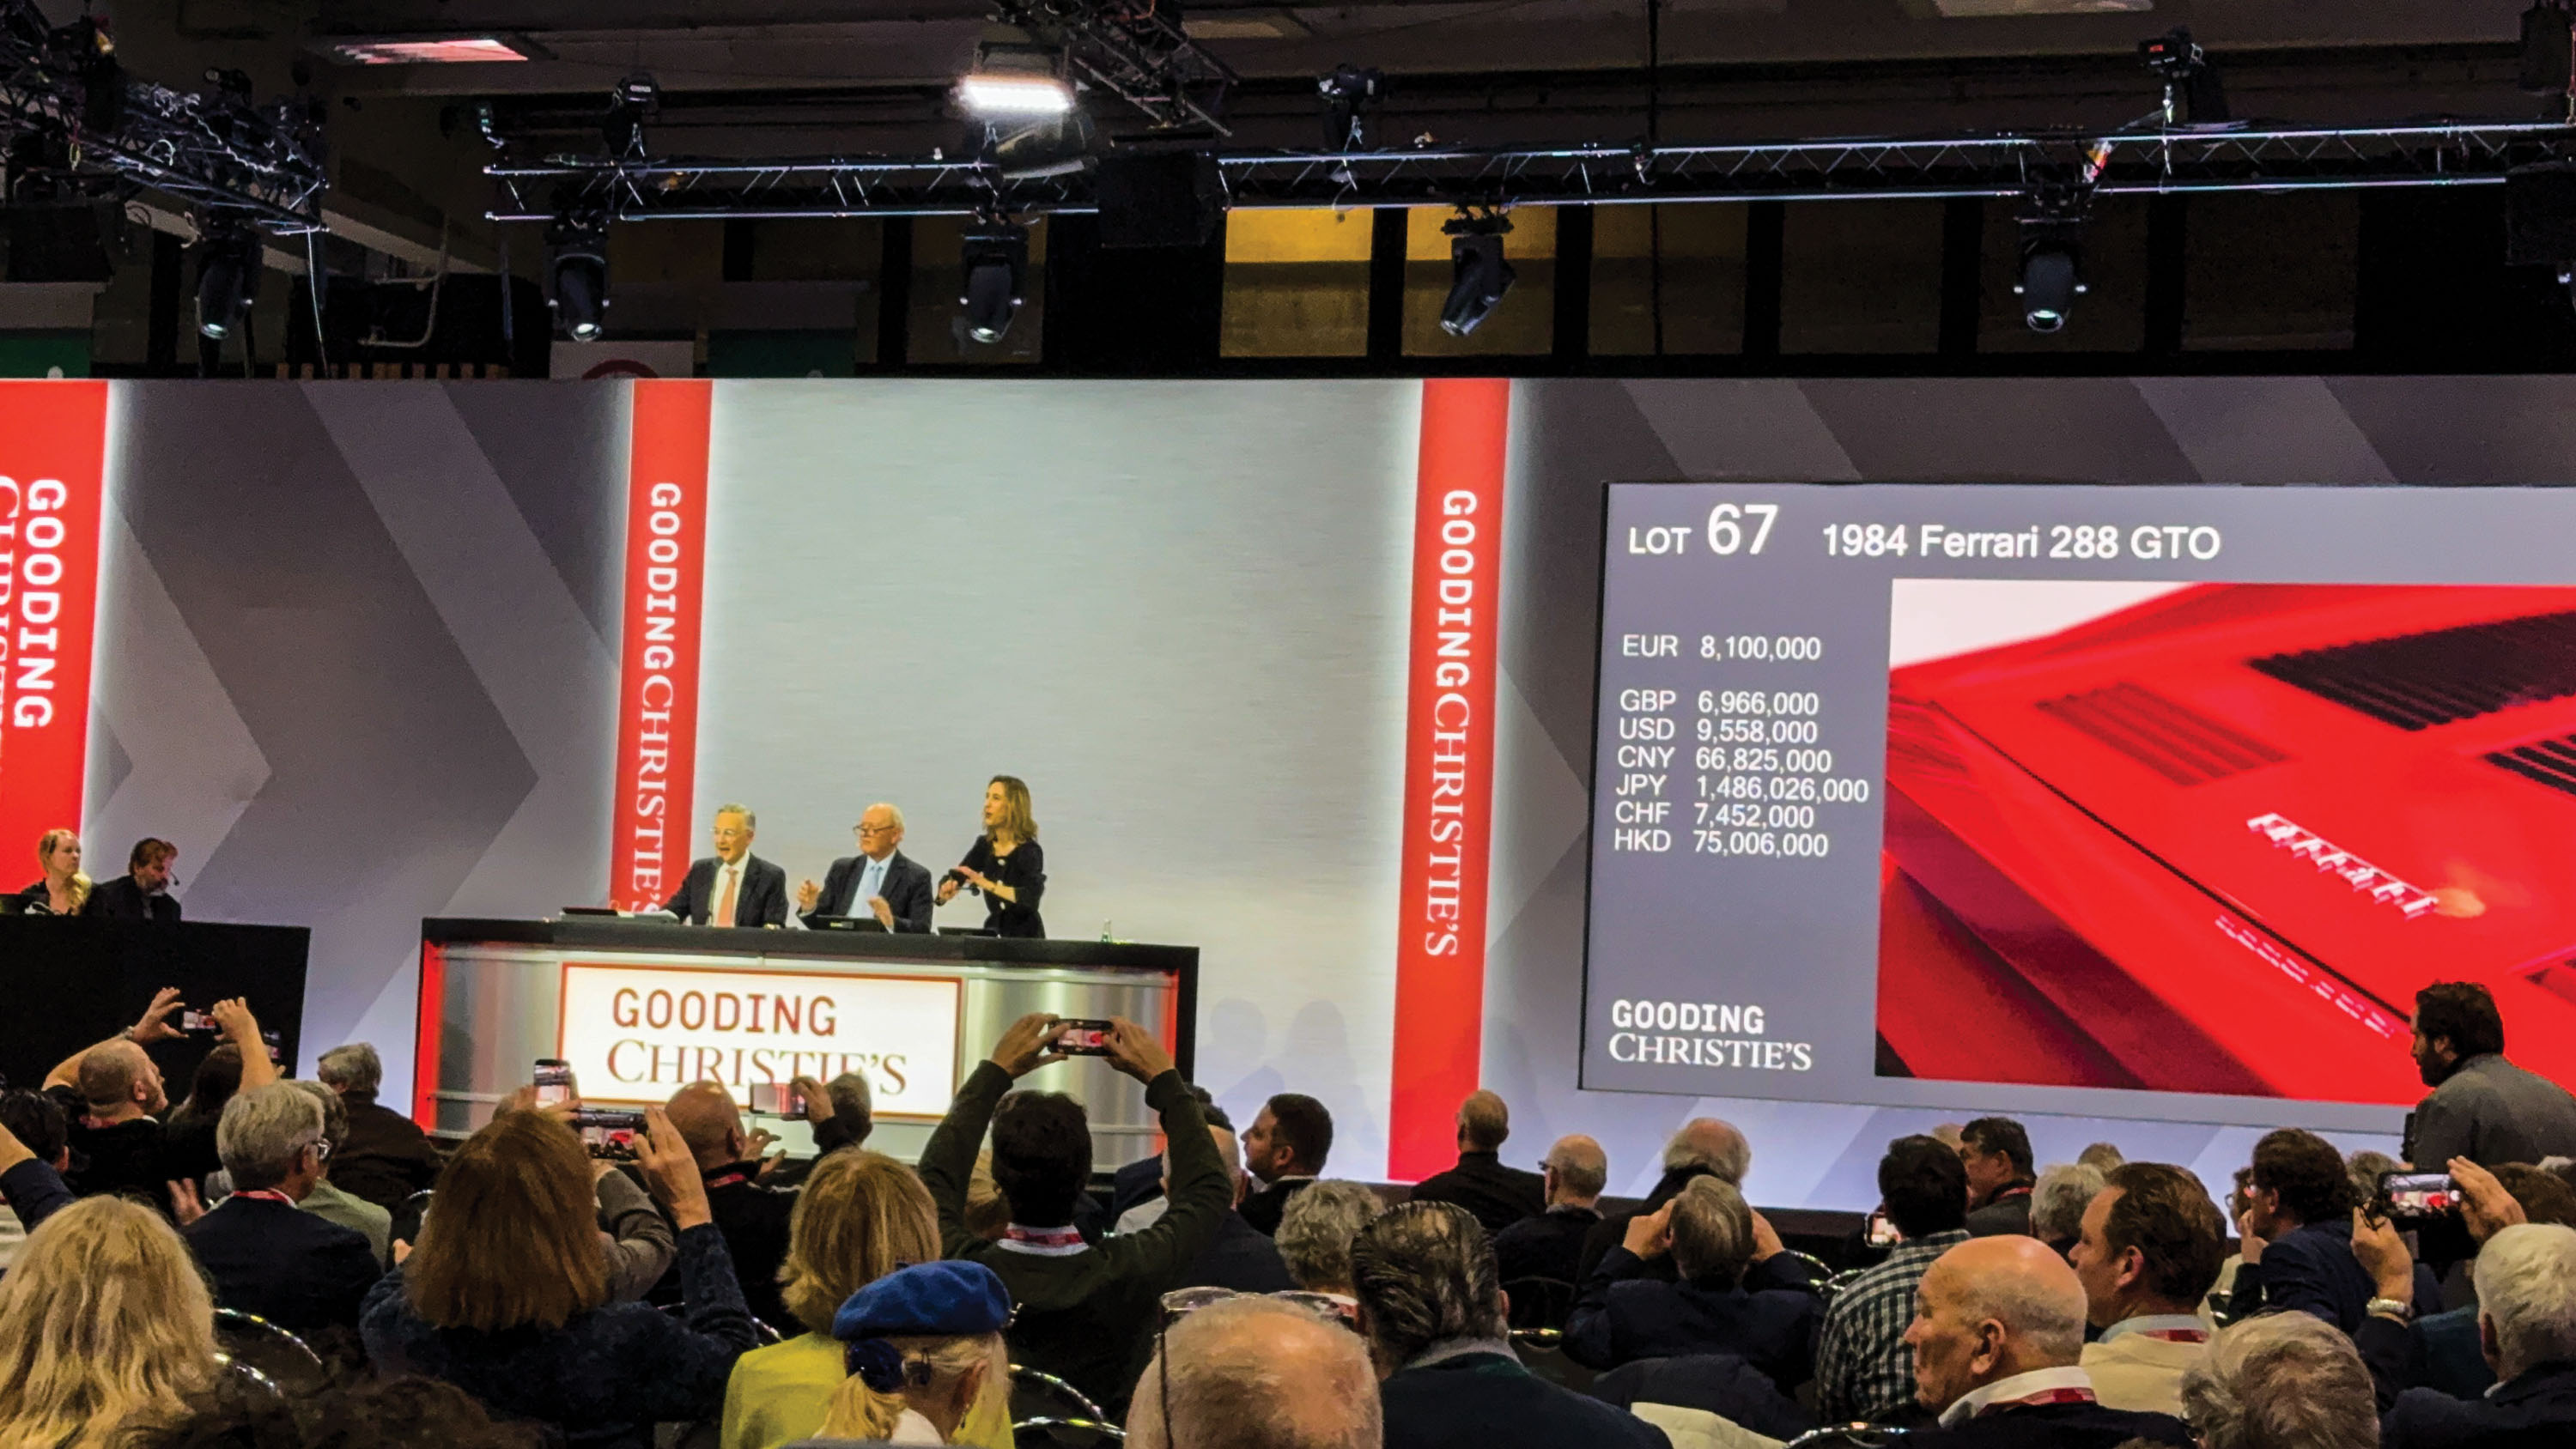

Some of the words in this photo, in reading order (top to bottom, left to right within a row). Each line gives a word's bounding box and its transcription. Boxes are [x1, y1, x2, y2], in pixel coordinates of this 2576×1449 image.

[1629, 526, 1692, 555] LOT
[1707, 503, 1778, 555] 67
[1823, 524, 1909, 558] 1984
[1920, 524, 2038, 558] Ferrari
[2049, 524, 2120, 560] 288
[2130, 525, 2221, 560] GTO
[13, 478, 67, 728] GOODING
[1622, 634, 1679, 658] EUR
[1700, 635, 1821, 662] 8,100,000
[1619, 689, 1677, 713] GBP
[1698, 690, 1819, 717] 6,966,000
[1619, 718, 1675, 741] USD
[1697, 718, 1818, 745] 9,558,000
[1618, 746, 1675, 769] CNY
[1695, 747, 1832, 774] 66,825,000
[1615, 774, 1668, 797] JPY
[1696, 776, 1869, 804] 1,486,026,000
[1615, 801, 1671, 825] CHF
[1693, 803, 1814, 830] 7,452,000
[1614, 828, 1671, 853] HKD
[1692, 830, 1829, 858] 75,006,000
[612, 987, 837, 1037] GOODING
[1612, 999, 1765, 1034] GOODING
[1608, 1032, 1813, 1071] CHRISTIE'S
